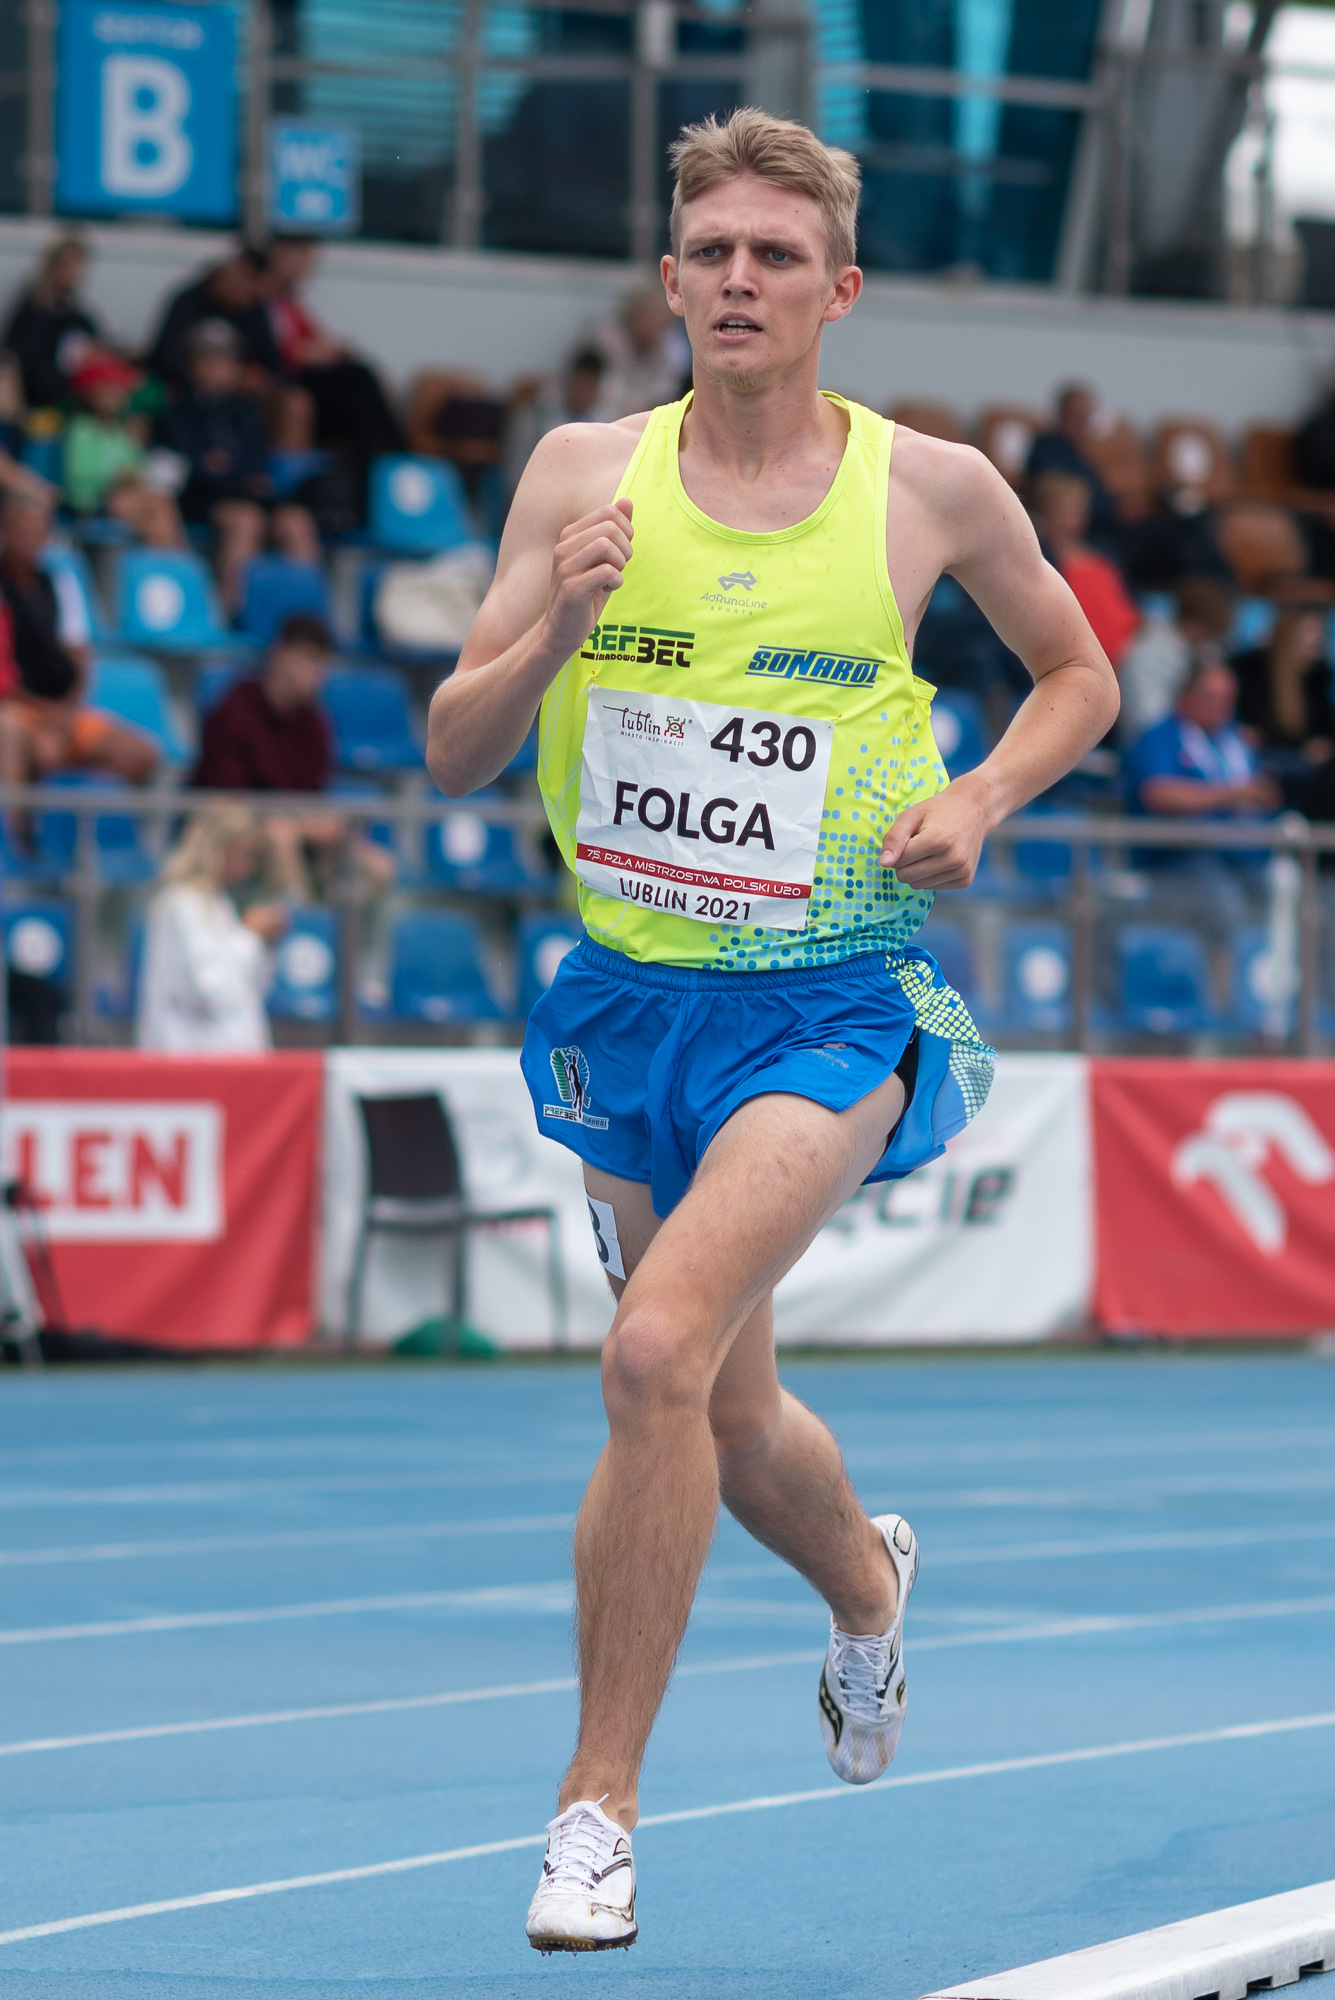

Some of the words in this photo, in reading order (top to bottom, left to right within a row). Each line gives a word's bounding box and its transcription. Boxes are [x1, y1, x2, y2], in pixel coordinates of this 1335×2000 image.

[101, 54, 194, 199] B
[747, 650, 879, 684] SONAROL
[710, 717, 816, 772] 430
[613, 780, 776, 851] FOLGA
[587, 848, 602, 861] 75.
[604, 852, 633, 868] PZLA
[634, 860, 720, 886] MISTRZOSTWA
[723, 877, 770, 893] POLSKI
[773, 885, 802, 897] U20
[619, 877, 688, 912] LUBLIN
[694, 894, 751, 921] 2021
[562, 1046, 579, 1056] KS
